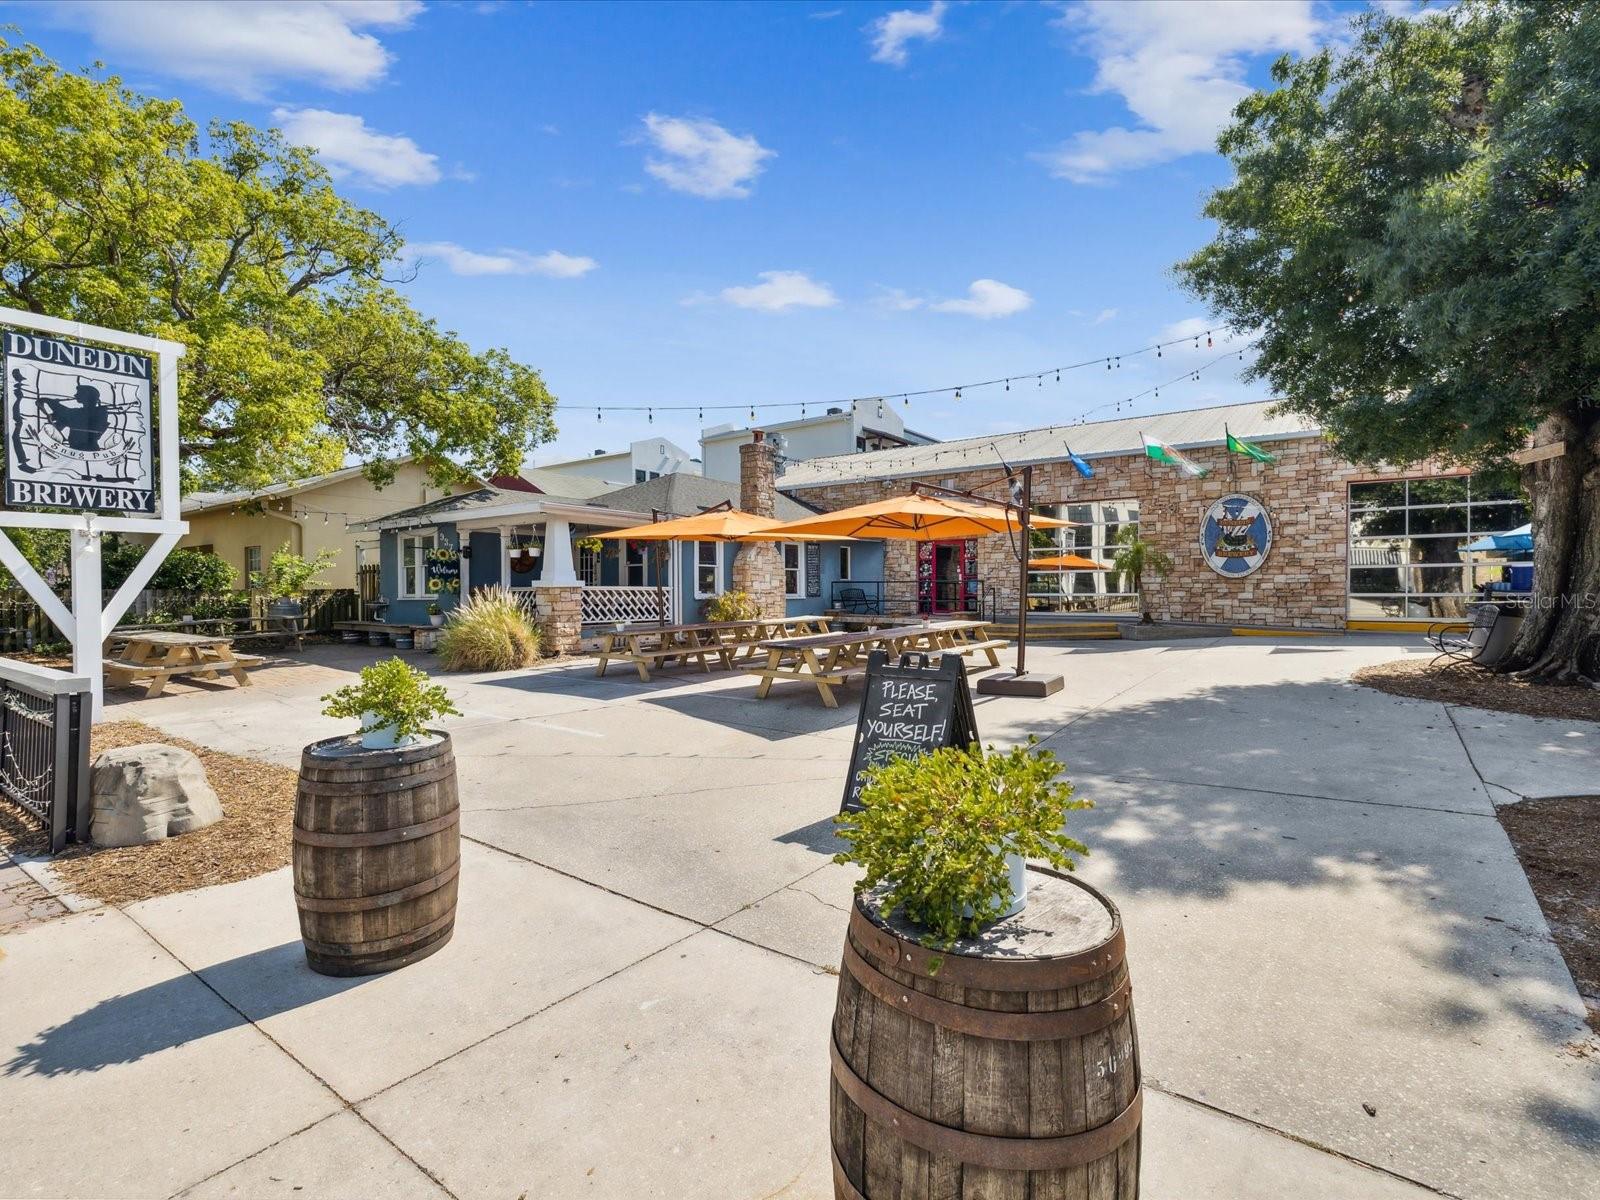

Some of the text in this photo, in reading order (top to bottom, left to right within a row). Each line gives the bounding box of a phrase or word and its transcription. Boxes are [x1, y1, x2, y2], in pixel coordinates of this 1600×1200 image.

[8, 333, 148, 378] DUNEDIN
[51, 443, 117, 460] Snug Pub
[11, 481, 151, 511] BREWERY
[882, 680, 938, 702] PLEASE,
[879, 703, 928, 719] SEAT
[867, 719, 947, 742] YOURSELF!
